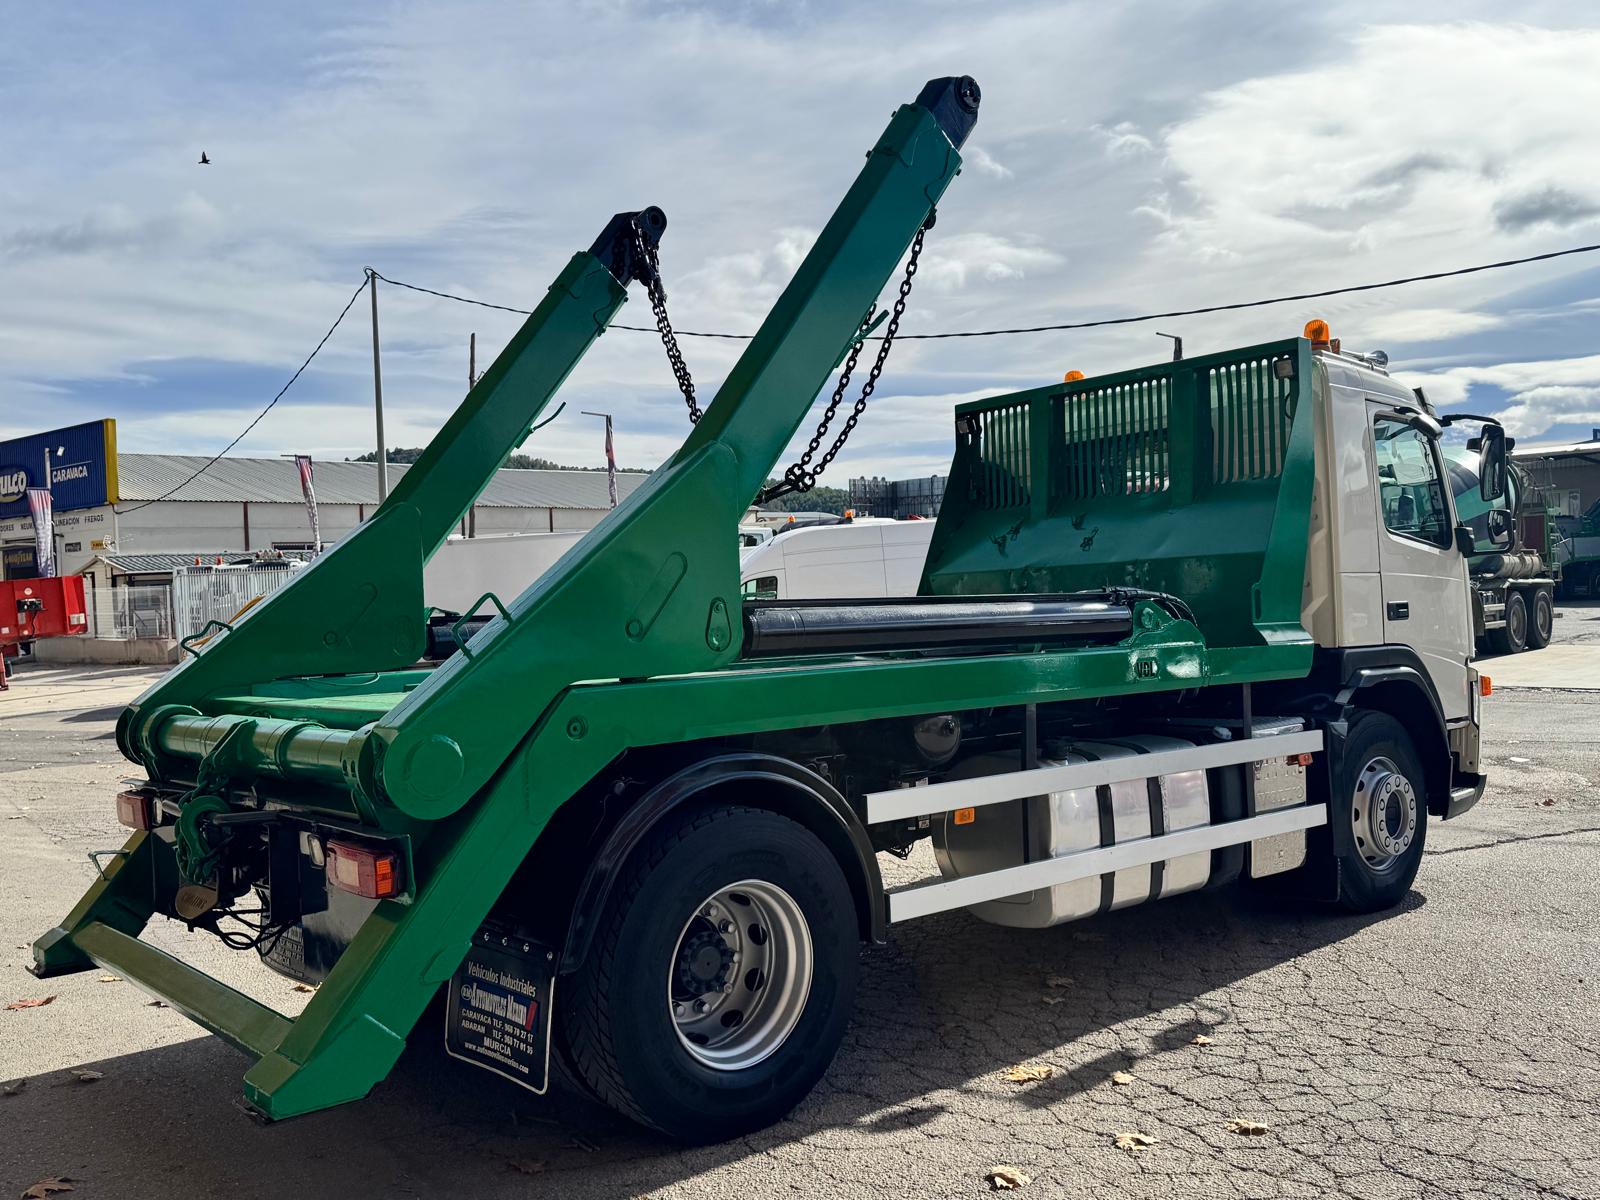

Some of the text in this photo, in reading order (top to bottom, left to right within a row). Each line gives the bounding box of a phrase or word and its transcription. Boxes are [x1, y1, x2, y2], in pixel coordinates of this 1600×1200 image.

[0, 471, 27, 494] ULCO
[52, 465, 88, 483] CARAVACA
[84, 514, 104, 524] FRENOS
[1136, 661, 1156, 678] VDL
[500, 972, 536, 997] Industriales
[461, 1008, 492, 1025] CARAVACA
[483, 1036, 512, 1056] MURCIA
